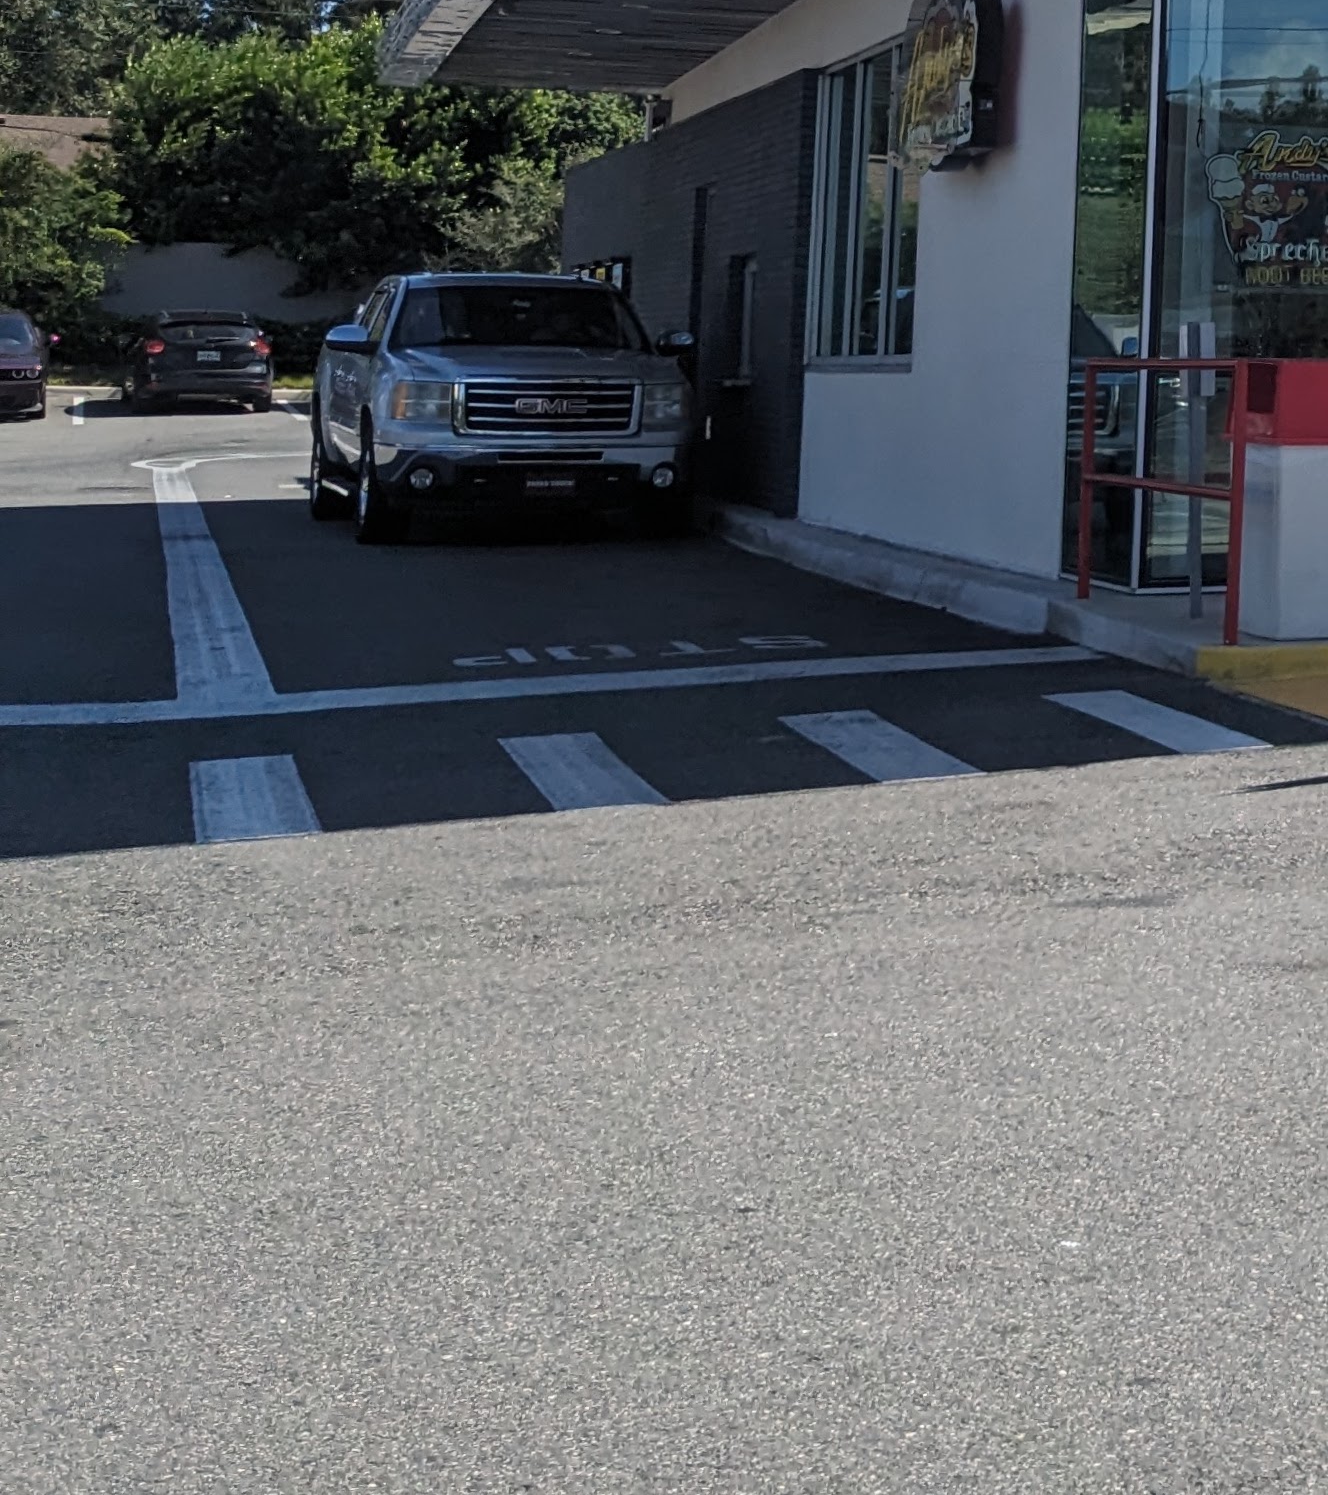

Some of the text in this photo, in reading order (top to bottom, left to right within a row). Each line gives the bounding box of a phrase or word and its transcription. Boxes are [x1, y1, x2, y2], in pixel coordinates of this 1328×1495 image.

[1252, 169, 1290, 182] Frozen
[1245, 265, 1290, 285] ROOT
[514, 397, 589, 415] GMC
[451, 633, 829, 668] STOP
